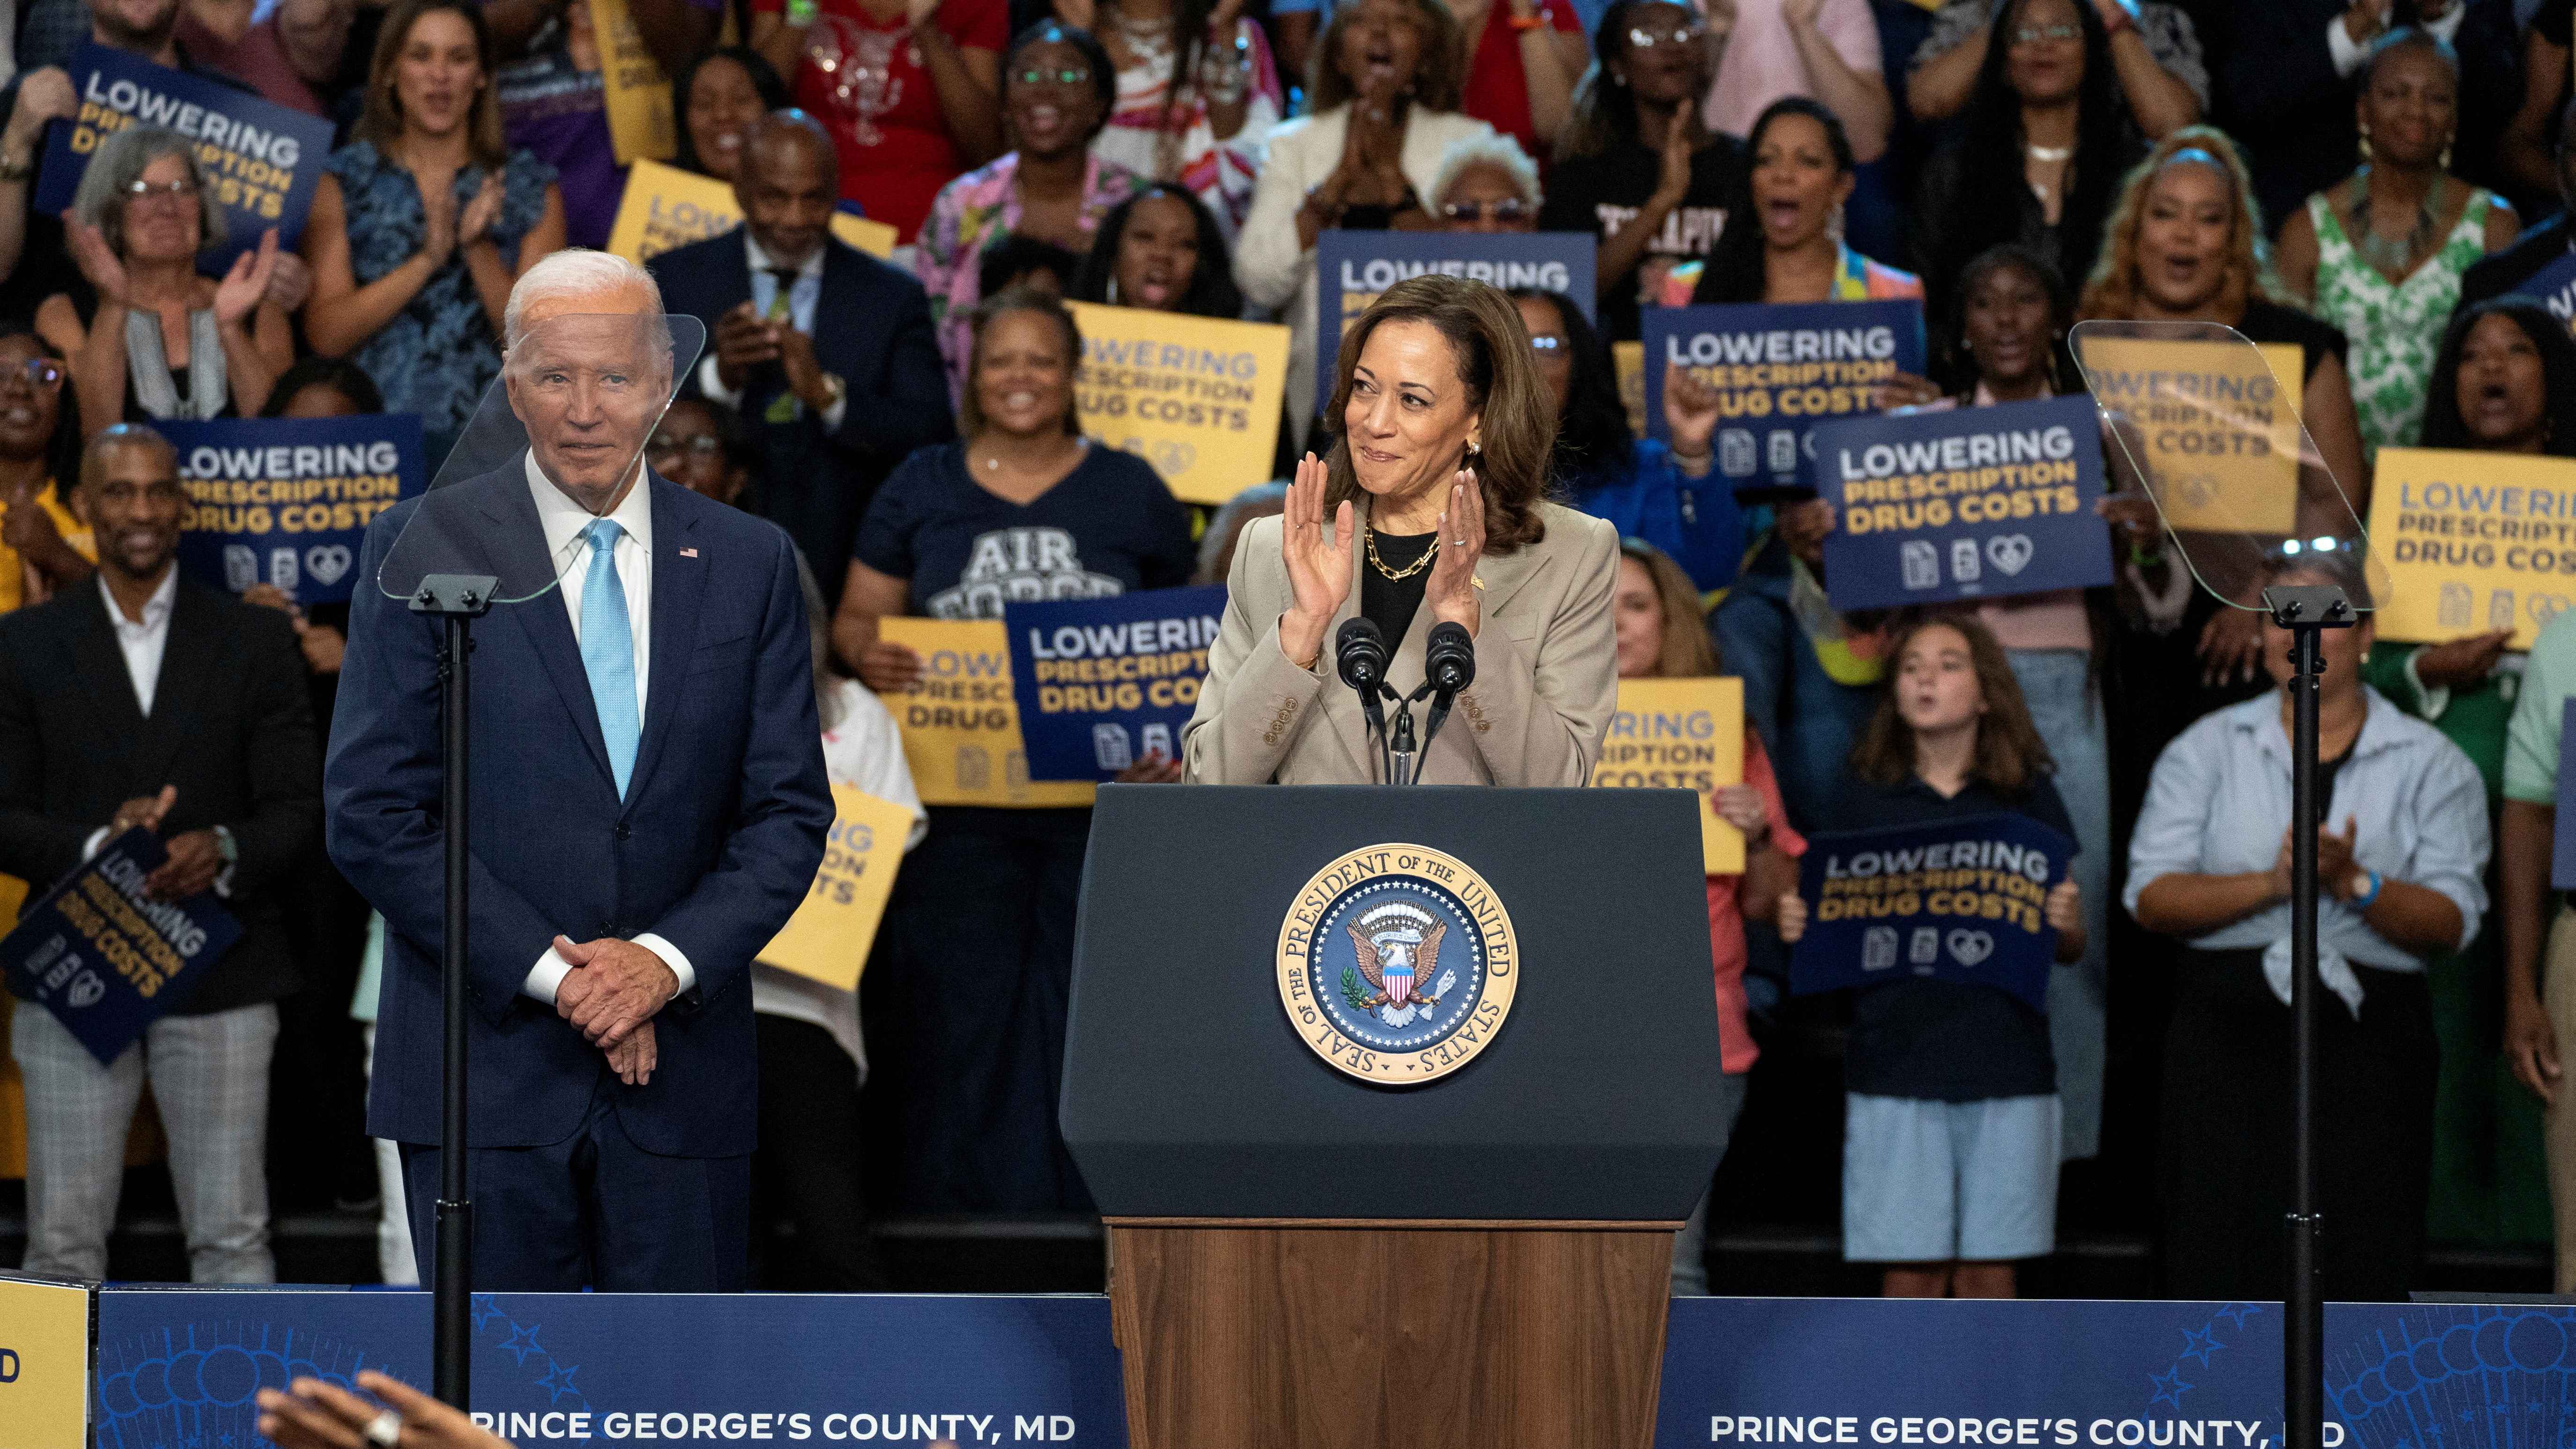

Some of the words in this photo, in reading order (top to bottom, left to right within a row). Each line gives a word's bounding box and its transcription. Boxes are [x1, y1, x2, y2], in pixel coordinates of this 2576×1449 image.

[84, 70, 299, 169] LOWERING
[1667, 327, 1896, 366] LOWERING
[1135, 396, 1249, 432] COSTS
[1778, 386, 1874, 417] COST
[1840, 425, 2075, 481] LOWERING
[2156, 427, 2273, 458] COSTS
[1844, 460, 2079, 505] PRESCRIPTION
[1846, 499, 1953, 535] DRUG
[1958, 485, 2080, 524] COSTS
[969, 527, 1079, 581] AIR
[2394, 539, 2496, 569] DRUG
[907, 702, 1008, 732] DRUG
[1039, 684, 1144, 714] DRUG
[1398, 855, 1421, 870] OF
[1426, 859, 1456, 884] THE
[1827, 840, 2049, 883] LOWERING
[1285, 852, 1391, 959] PRESIDENT
[1817, 891, 1921, 922] DRUG
[1460, 879, 1510, 978] UNITED
[95, 928, 165, 998] COSTS
[1288, 967, 1308, 1001] THE
[1297, 1003, 1317, 1025] OF
[1316, 1023, 1377, 1072] SEAL
[1420, 998, 1500, 1072] STATES
[604, 1412, 812, 1440] GEORGE'S
[823, 1413, 1001, 1445] COUNTY,
[1014, 1415, 1076, 1441] MD
[1711, 1416, 1858, 1442] PRINCE
[1871, 1417, 2079, 1445] GEORGE'S
[2089, 1419, 2270, 1449] COUNTY,
[2283, 1421, 2345, 1448] D
